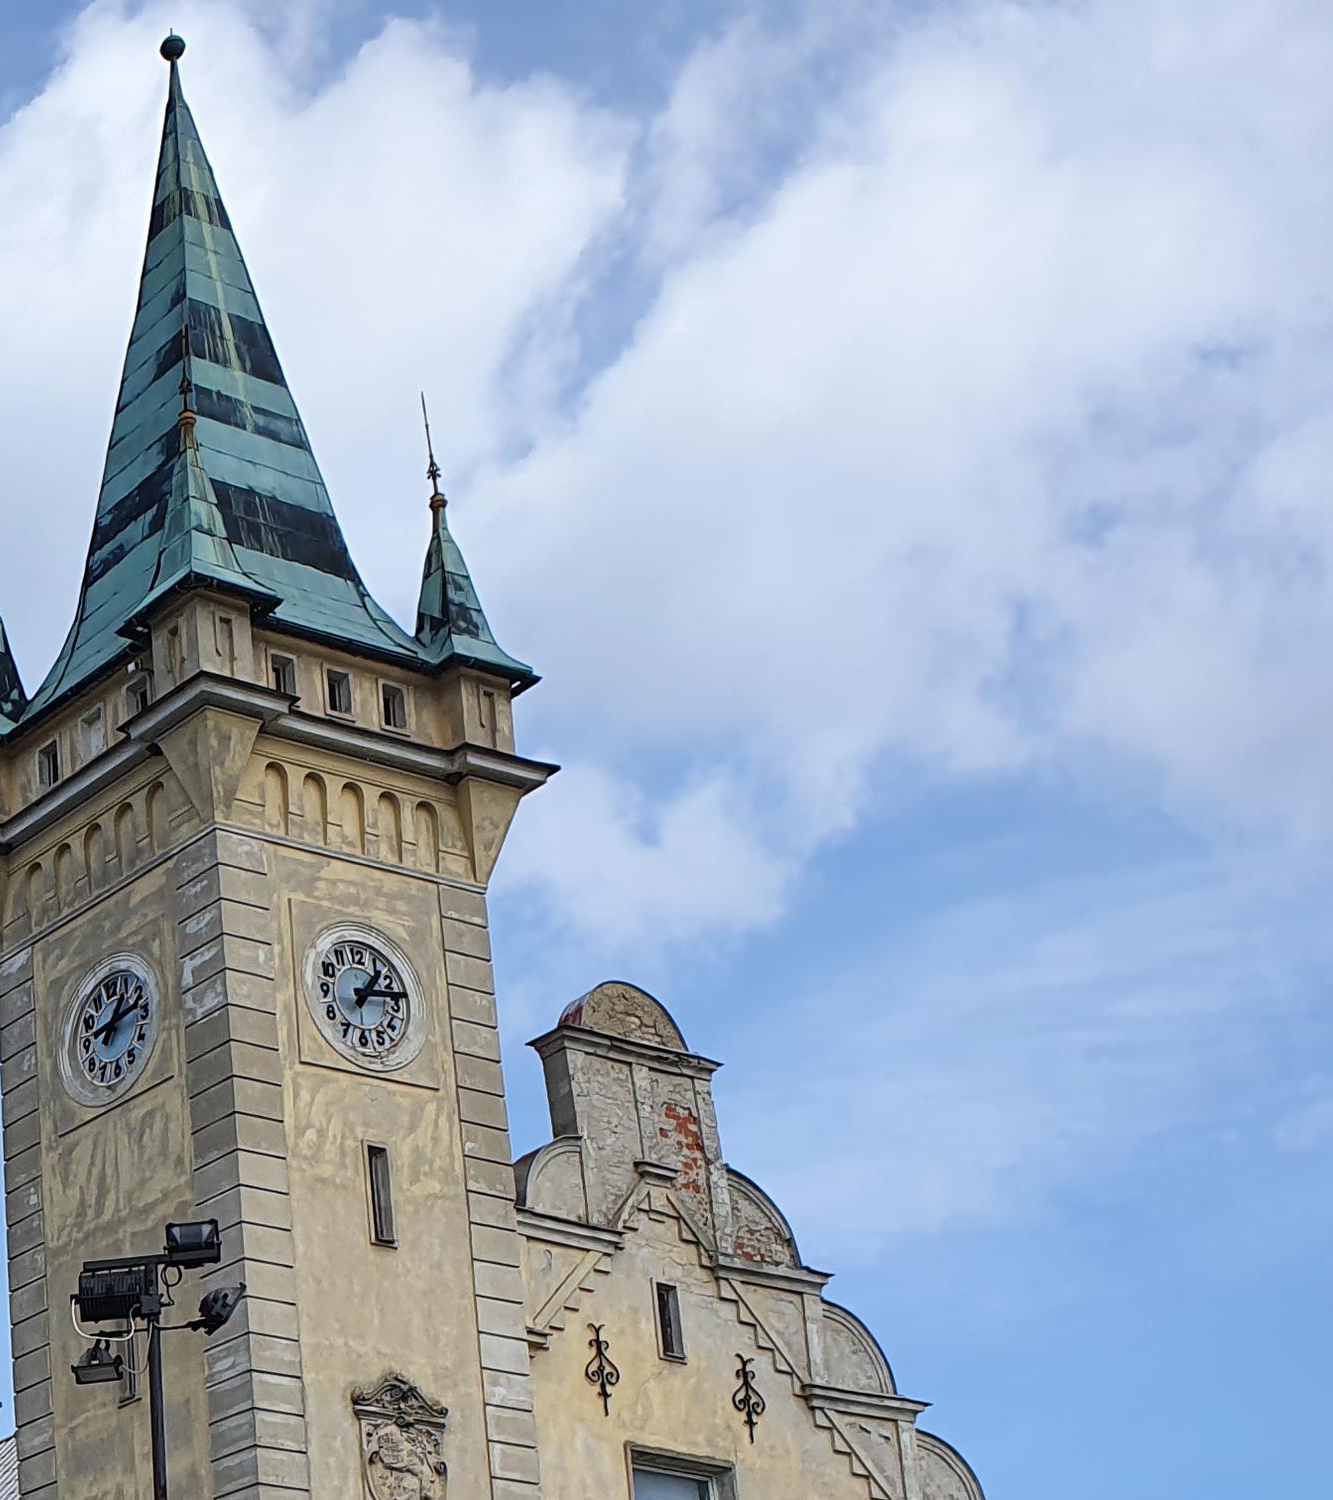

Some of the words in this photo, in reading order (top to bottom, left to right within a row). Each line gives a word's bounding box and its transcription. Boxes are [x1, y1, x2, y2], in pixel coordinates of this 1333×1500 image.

[320, 982, 330, 998] 9
[326, 1004, 336, 1020] 8
[359, 1030, 368, 1047] 6
[376, 1030, 385, 1046] 5
